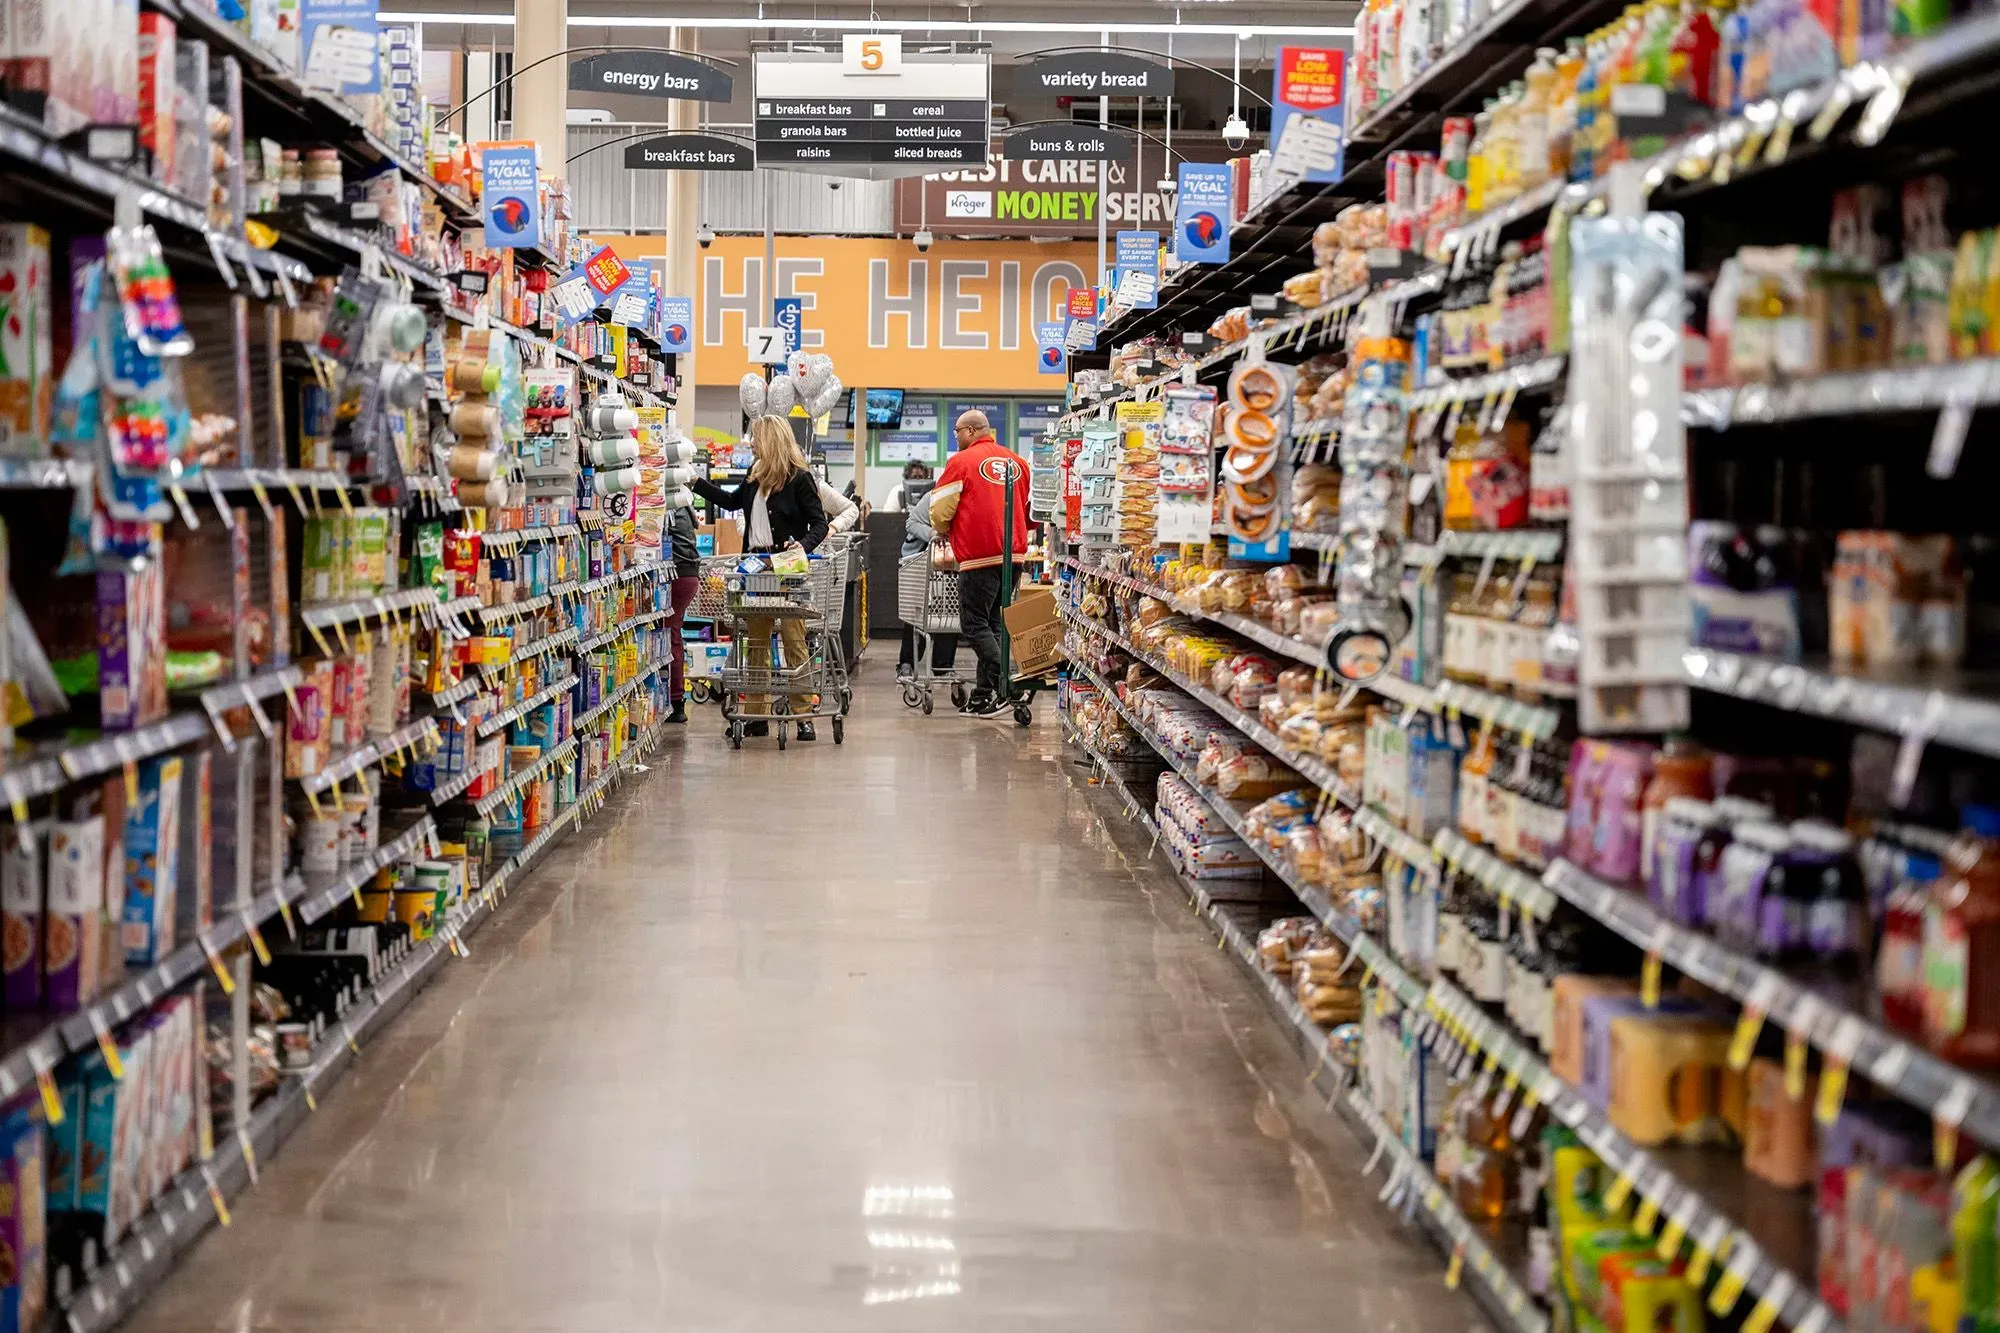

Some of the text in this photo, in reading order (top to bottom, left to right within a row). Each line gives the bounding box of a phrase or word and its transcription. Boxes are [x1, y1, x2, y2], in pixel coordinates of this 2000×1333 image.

[861, 41, 884, 71] 5
[1296, 62, 1329, 72] LOW
[603, 69, 699, 91] energy bars
[1042, 71, 1148, 89] variety bread
[1287, 72, 1336, 84] PRICES
[776, 103, 827, 115] breakfast
[829, 104, 852, 115] bars
[913, 104, 944, 116] cereal
[781, 125, 847, 138] granola bars
[896, 126, 962, 139] bottled juice
[796, 147, 831, 158] raisins
[894, 147, 963, 159] sliced breads
[1030, 139, 1105, 153] buns & rolls
[644, 149, 735, 164] breakfast bars
[1021, 159, 1097, 184] CARE
[1108, 160, 1126, 185] &
[1185, 173, 1203, 181] SAVE
[1216, 174, 1227, 182] TO
[951, 194, 987, 214] Kroger
[996, 190, 1098, 220] MONEY
[596, 259, 618, 285] PRICES
[605, 258, 621, 276] LOW
[758, 335, 773, 355] 7
